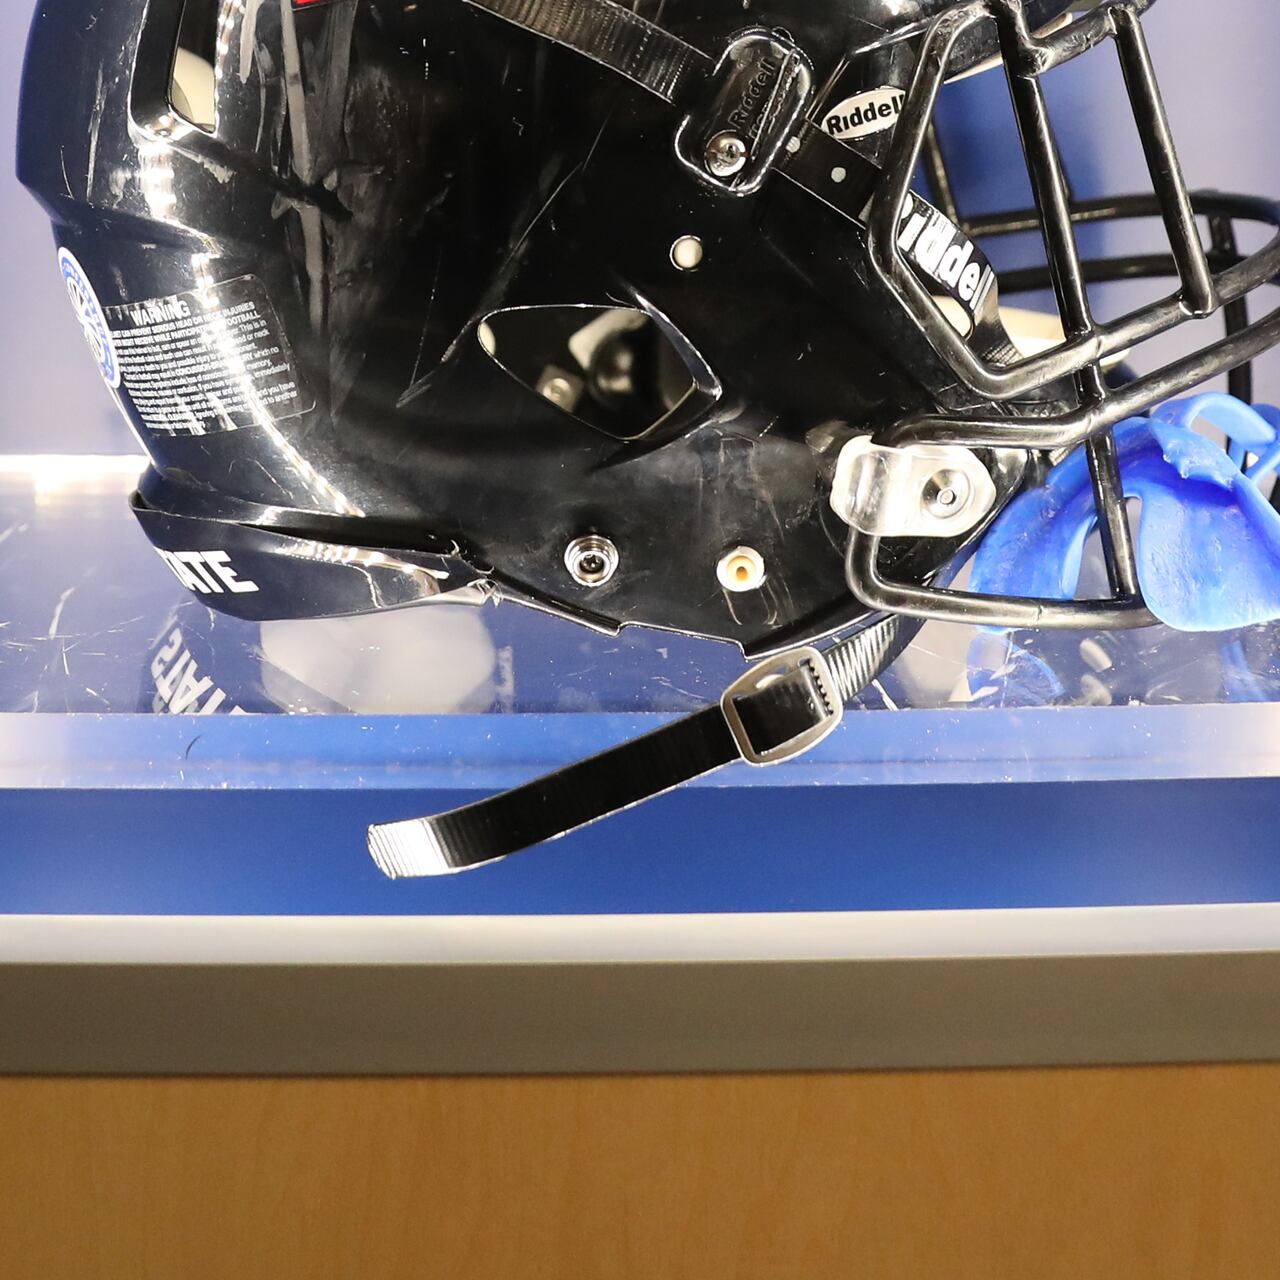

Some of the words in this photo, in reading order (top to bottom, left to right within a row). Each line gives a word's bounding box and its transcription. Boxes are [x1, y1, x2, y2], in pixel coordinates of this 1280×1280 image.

[130, 301, 191, 326] WARNING
[222, 301, 255, 317] INJURIES
[224, 310, 261, 327] OOTBALL
[239, 322, 253, 332] This
[253, 348, 271, 358] which
[270, 346, 279, 354] no
[267, 386, 280, 396] you
[278, 381, 296, 392] have
